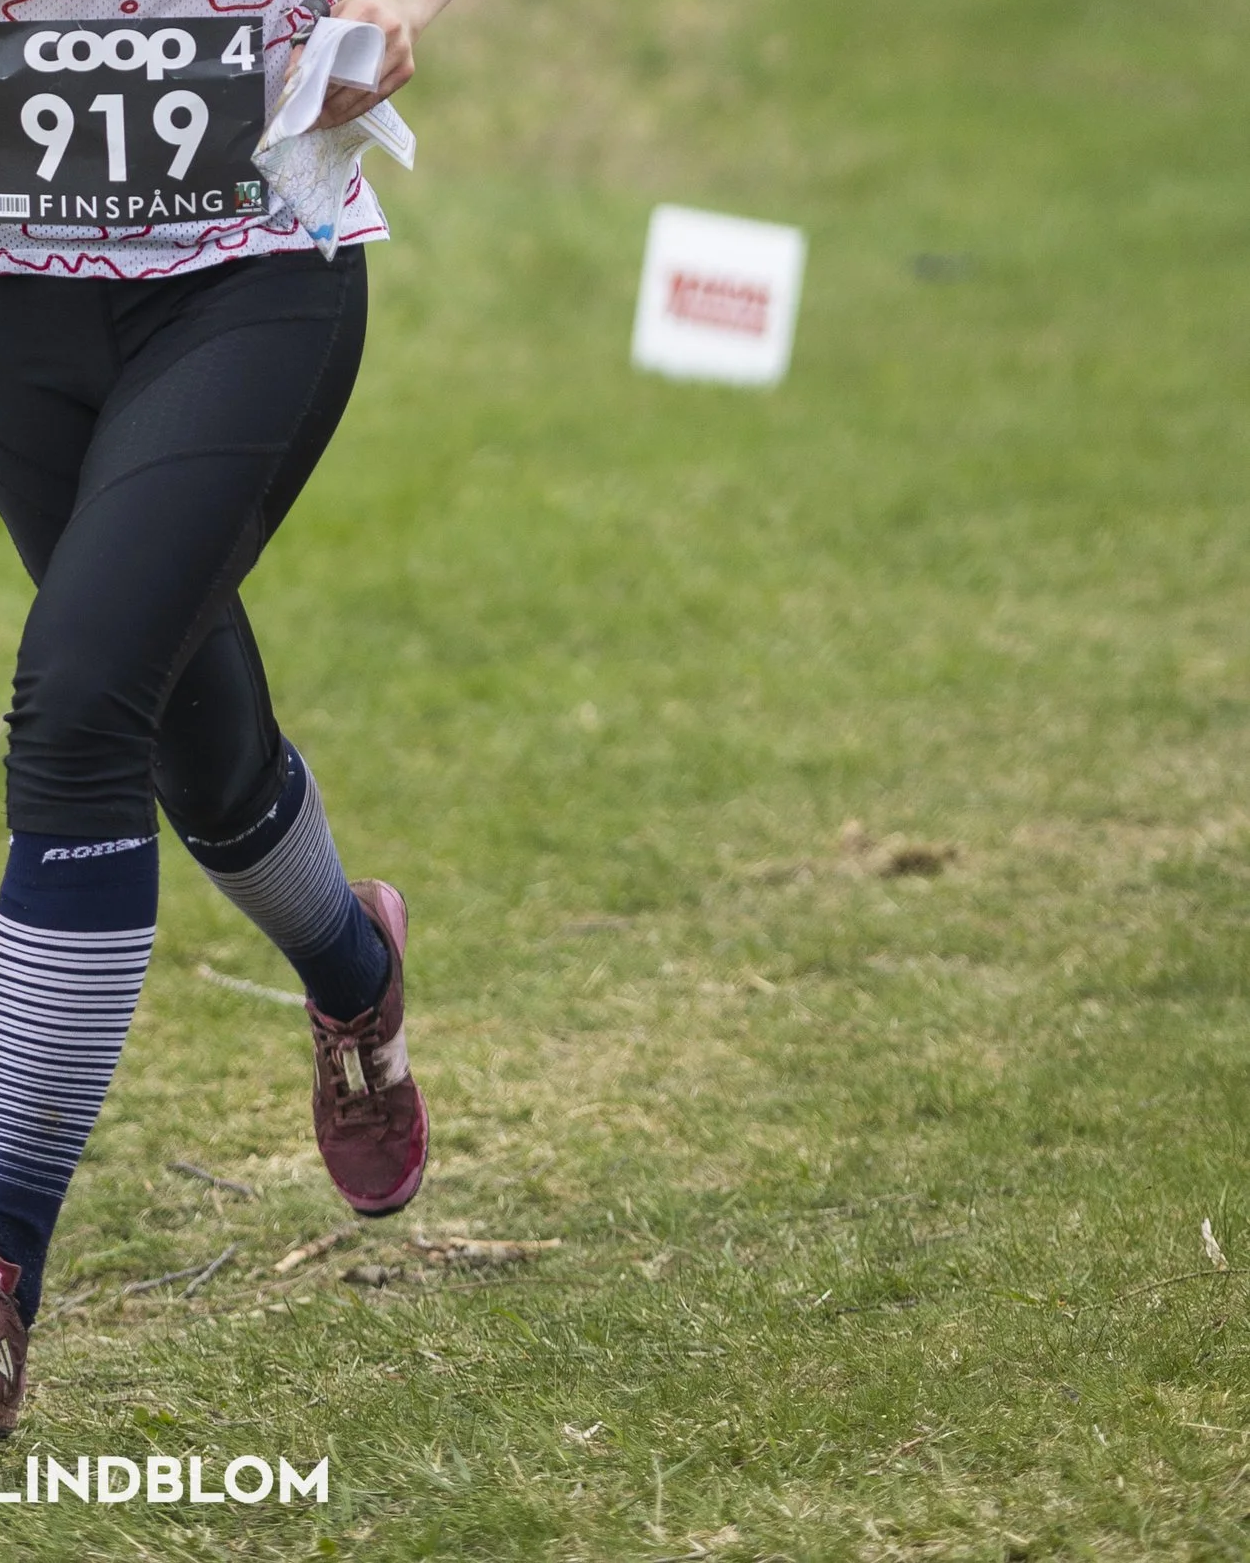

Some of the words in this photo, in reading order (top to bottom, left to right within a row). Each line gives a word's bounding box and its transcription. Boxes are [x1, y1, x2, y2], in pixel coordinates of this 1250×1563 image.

[23, 27, 197, 81] coop
[221, 25, 255, 71] 4
[20, 89, 209, 182] 919
[39, 189, 223, 218] FINSPÅNG
